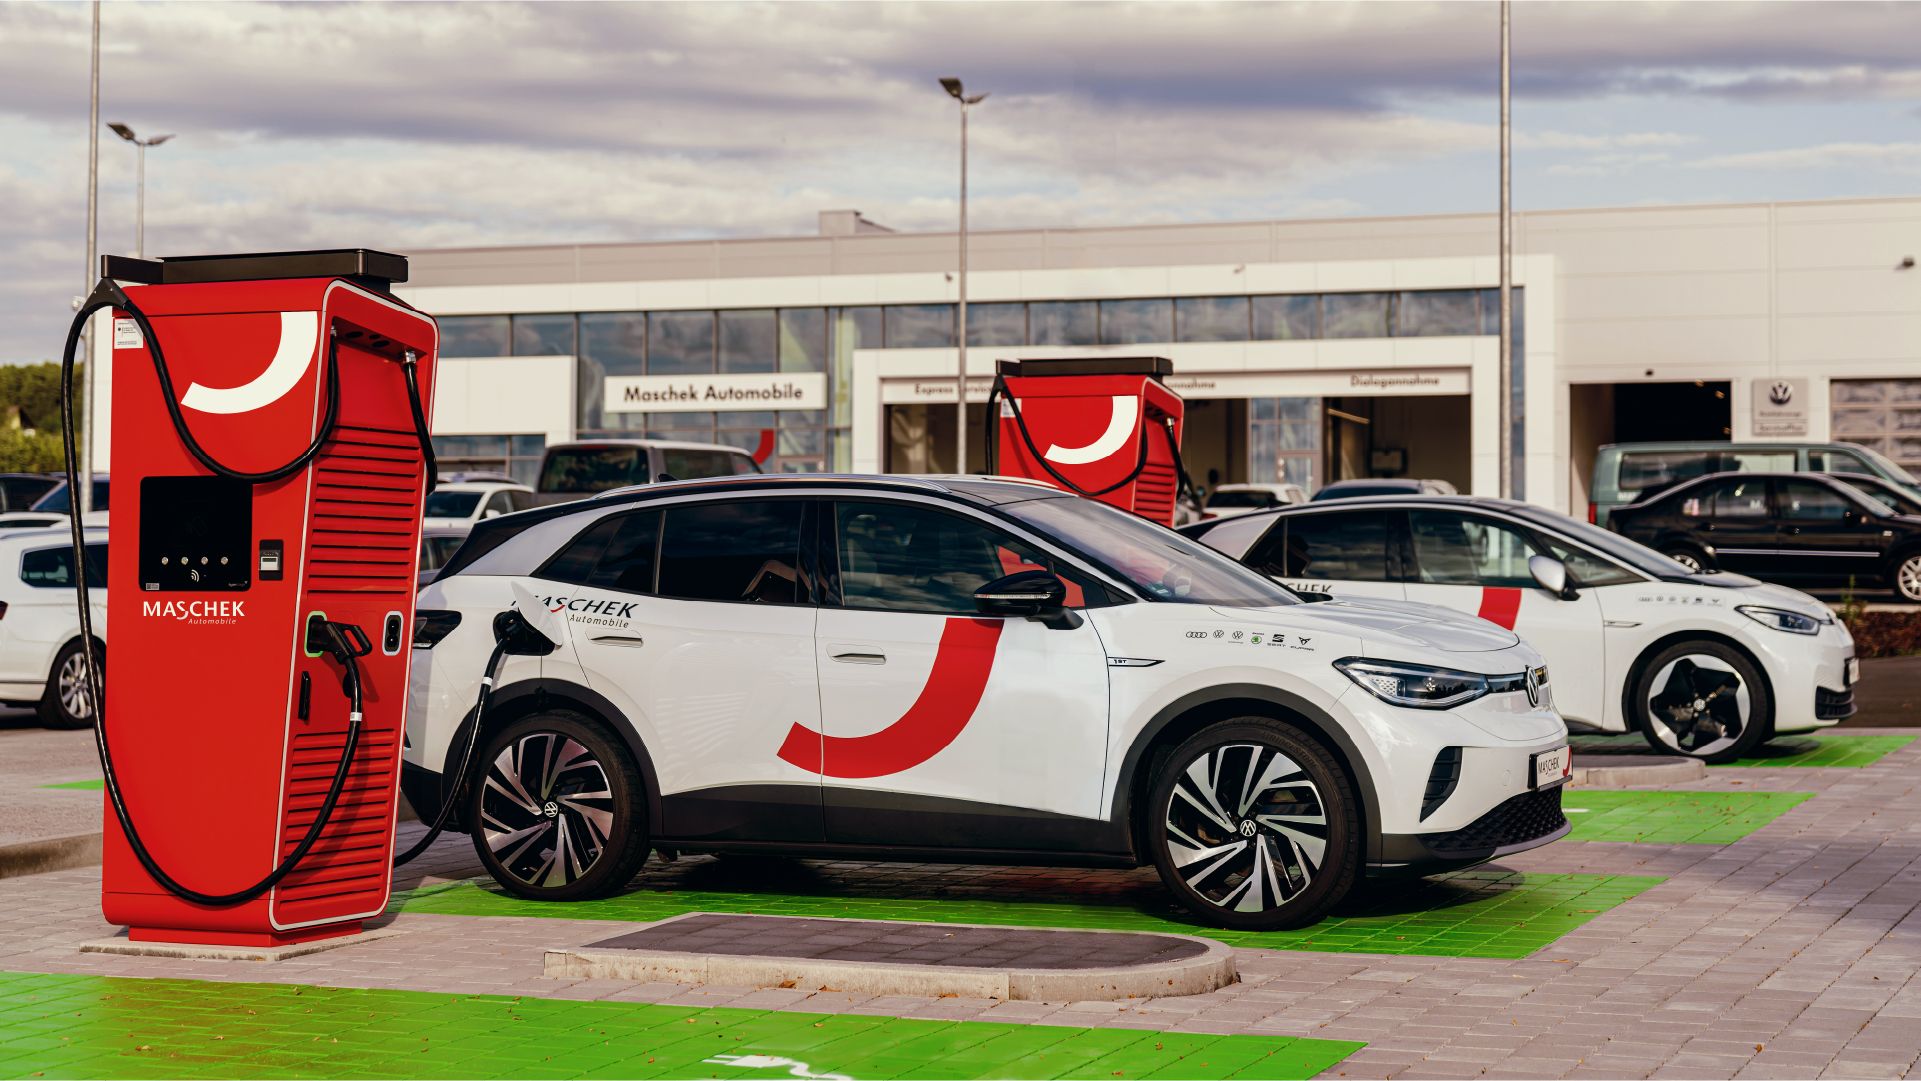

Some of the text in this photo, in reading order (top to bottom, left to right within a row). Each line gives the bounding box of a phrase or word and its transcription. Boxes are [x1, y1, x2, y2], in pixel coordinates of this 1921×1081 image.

[624, 382, 803, 403] Maschek Automobile
[142, 600, 246, 620] MASCHEK
[187, 617, 237, 625] Automobile
[569, 613, 630, 629] Automobile
